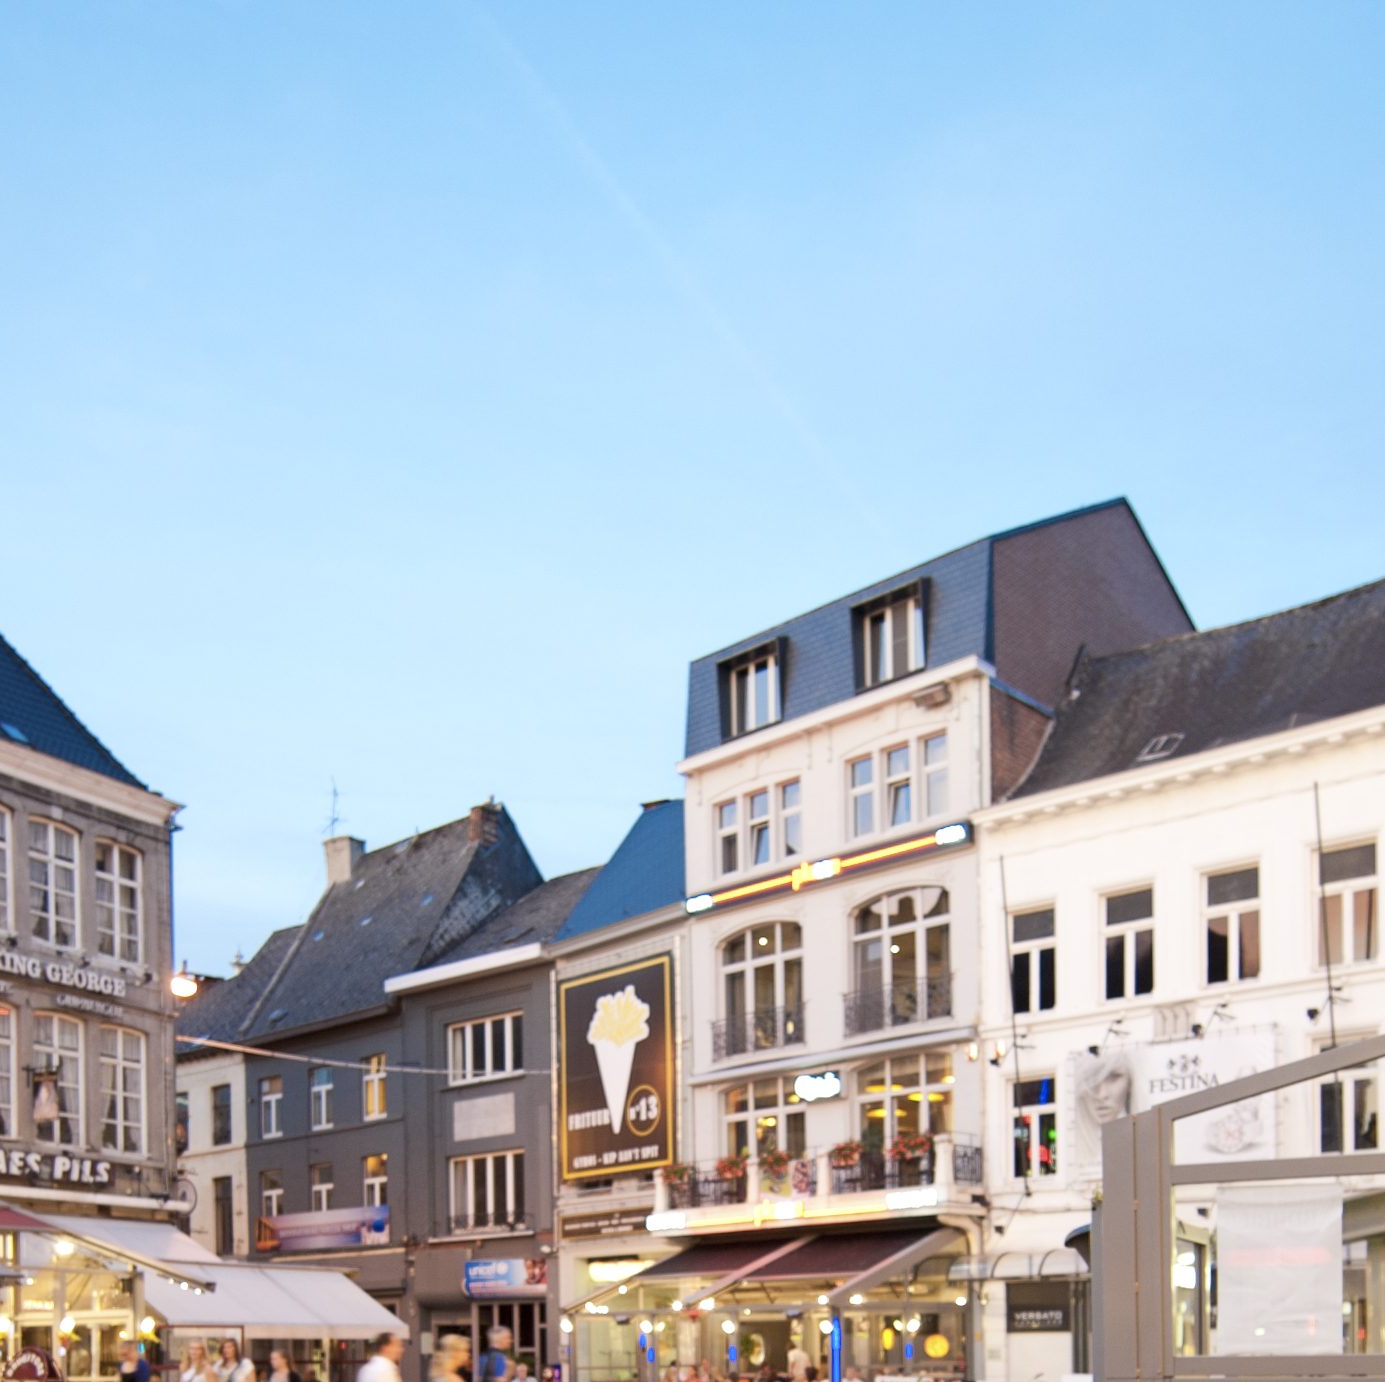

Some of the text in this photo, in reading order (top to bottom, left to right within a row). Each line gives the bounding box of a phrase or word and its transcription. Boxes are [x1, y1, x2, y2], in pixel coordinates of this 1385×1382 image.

[47, 963, 126, 997] GEORGE
[1149, 1073, 1220, 1094] FESTINA
[53, 1155, 112, 1183] PILS
